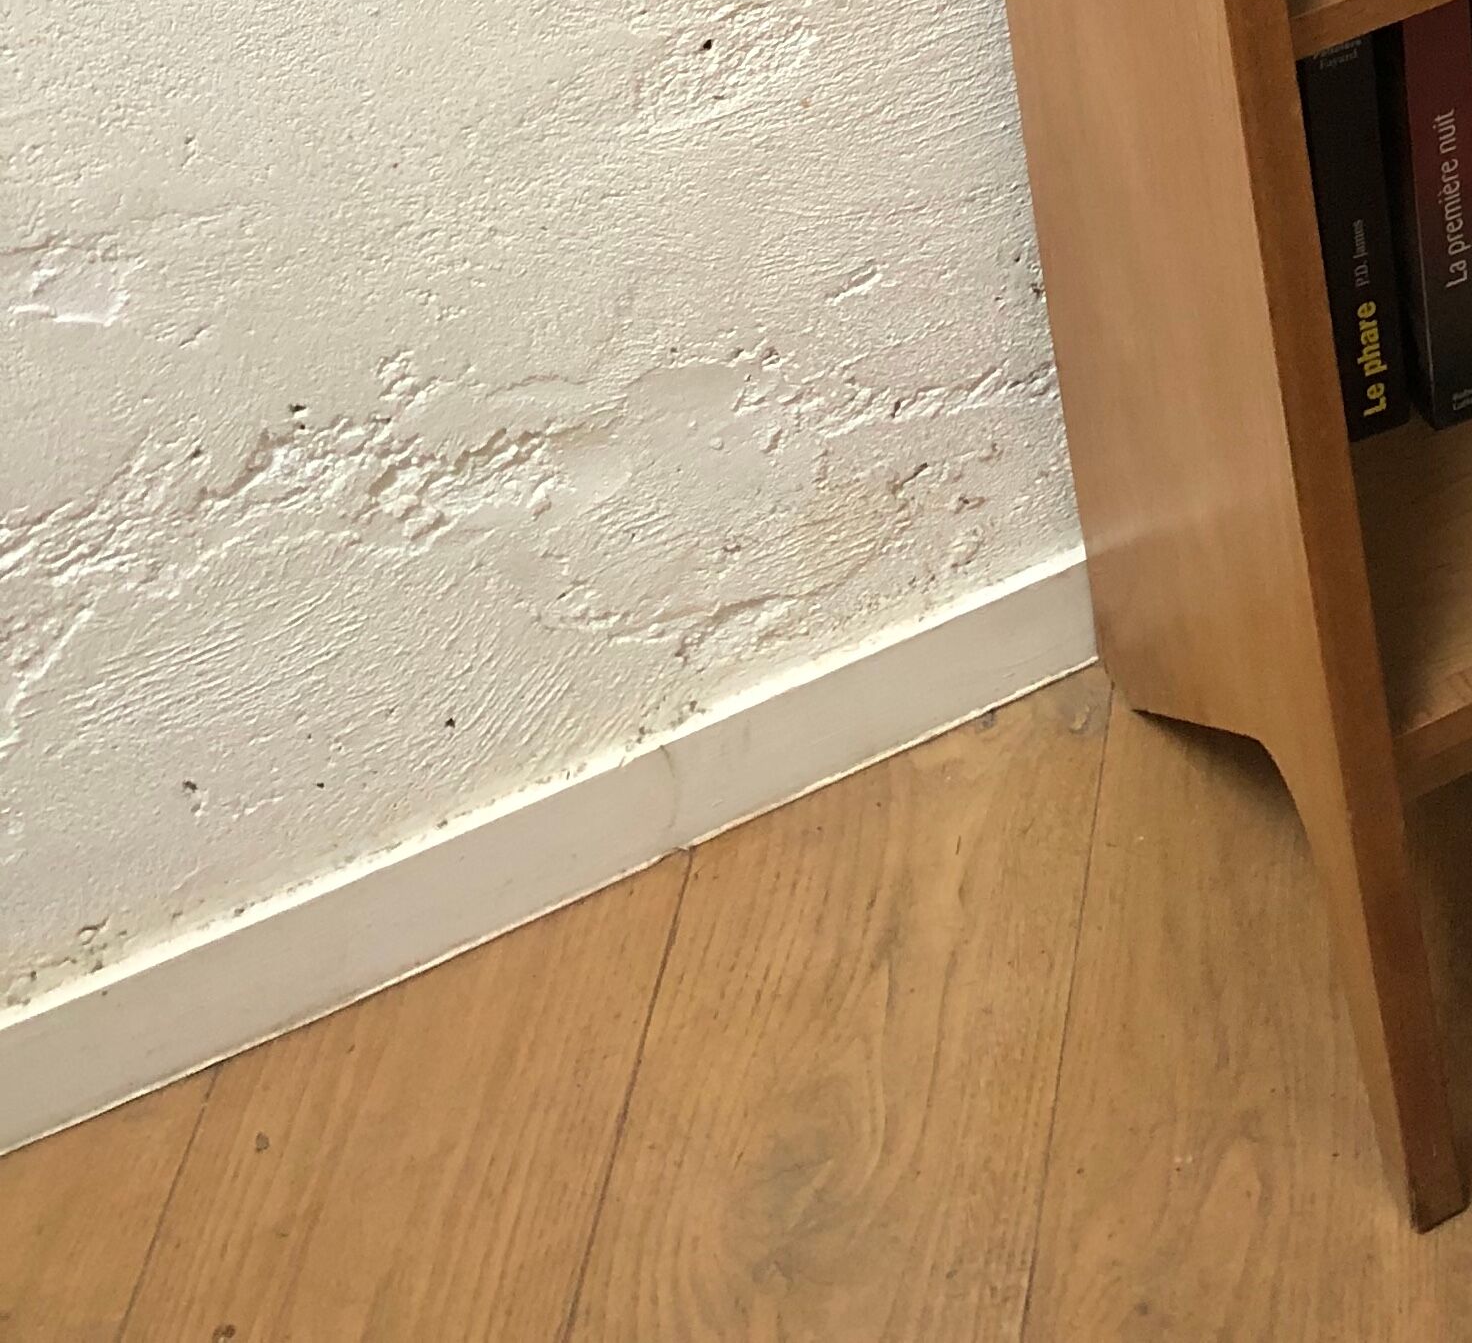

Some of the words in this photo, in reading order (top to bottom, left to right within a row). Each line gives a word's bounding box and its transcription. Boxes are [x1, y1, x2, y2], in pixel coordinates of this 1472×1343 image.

[1432, 109, 1456, 154] nuit
[1437, 156, 1472, 261] première
[1352, 219, 1366, 261] James
[1446, 261, 1468, 288] La
[1357, 300, 1387, 377] phare
[1363, 383, 1387, 417] Le
